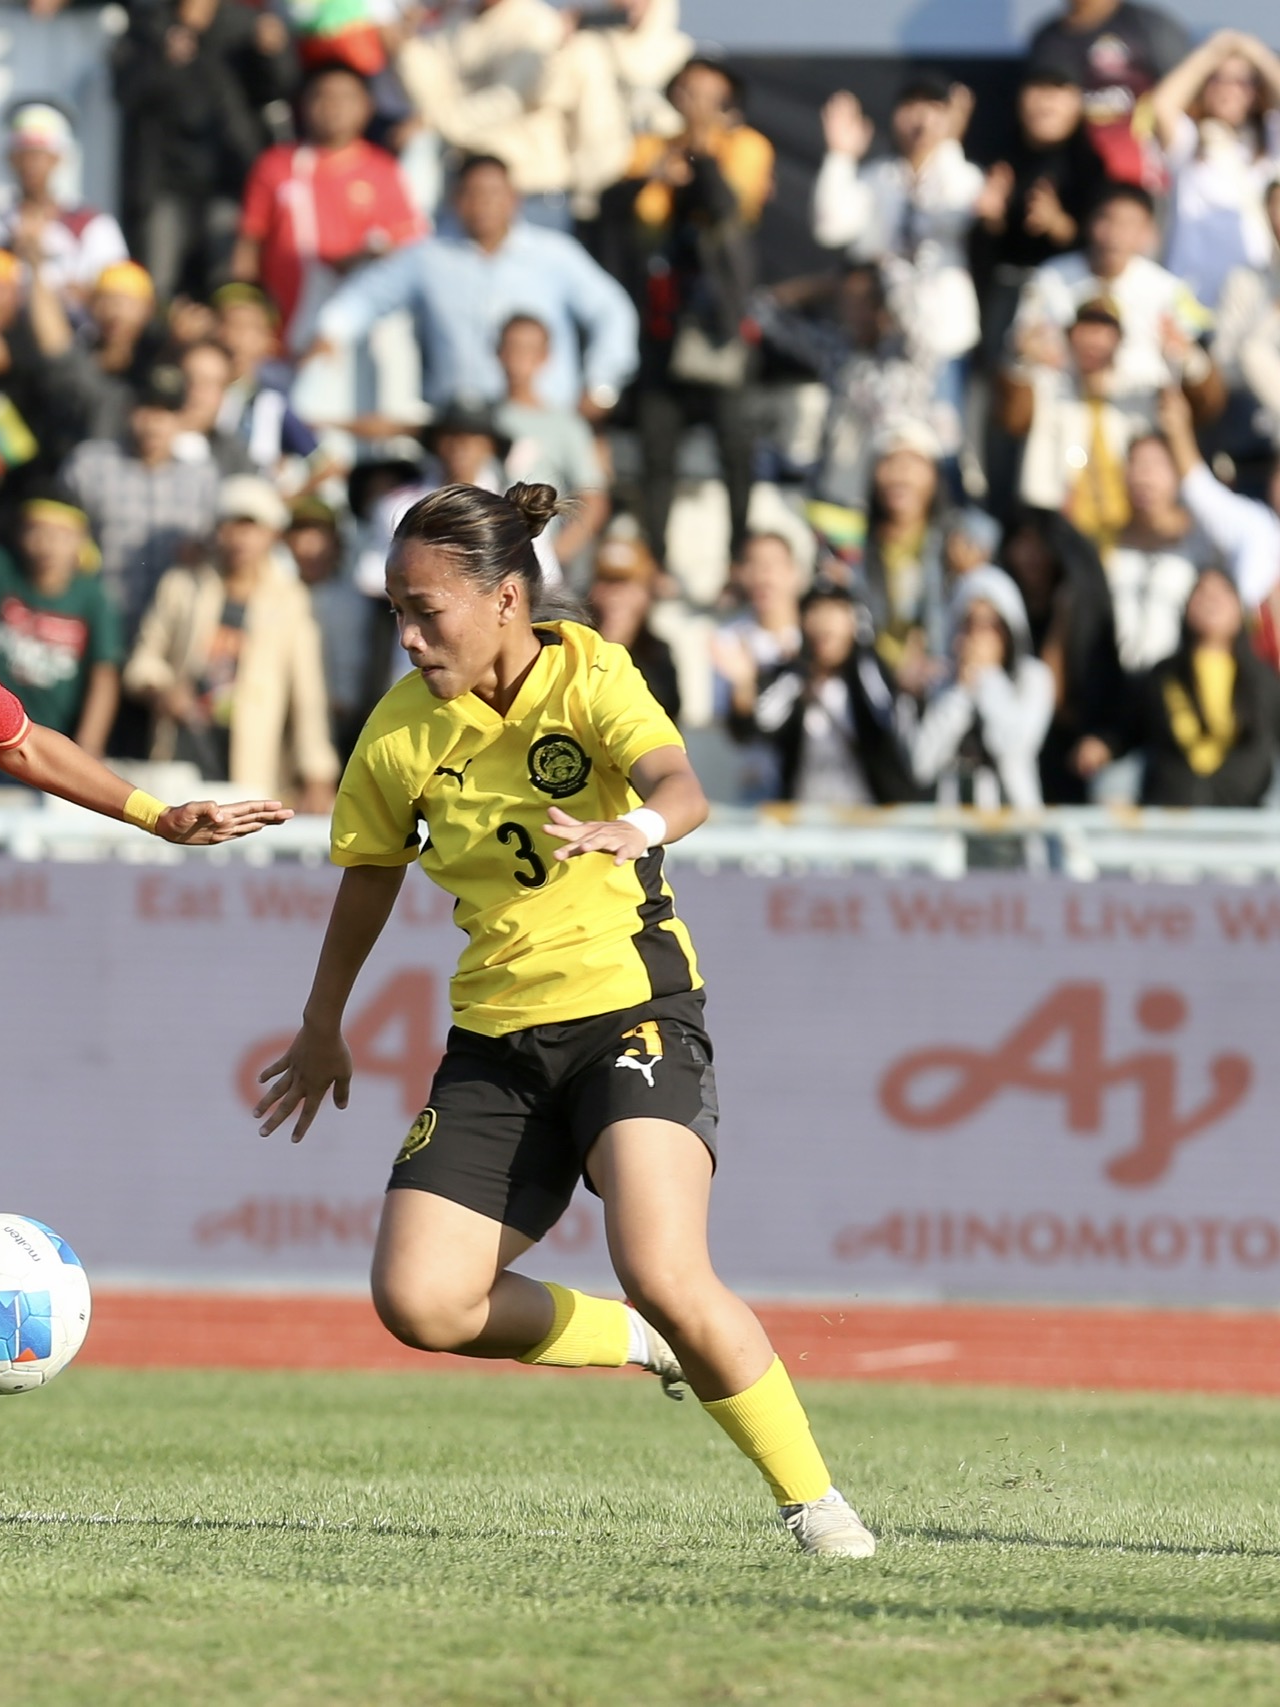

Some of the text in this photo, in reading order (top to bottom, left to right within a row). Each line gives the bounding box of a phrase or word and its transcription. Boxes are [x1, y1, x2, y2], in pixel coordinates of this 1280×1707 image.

[496, 821, 548, 889] 3
[135, 873, 223, 924] Eat
[765, 886, 863, 937] Eat
[1065, 894, 1196, 946] Live
[3, 1226, 41, 1262] molten
[832, 1206, 1280, 1270] AJINOMOTO
